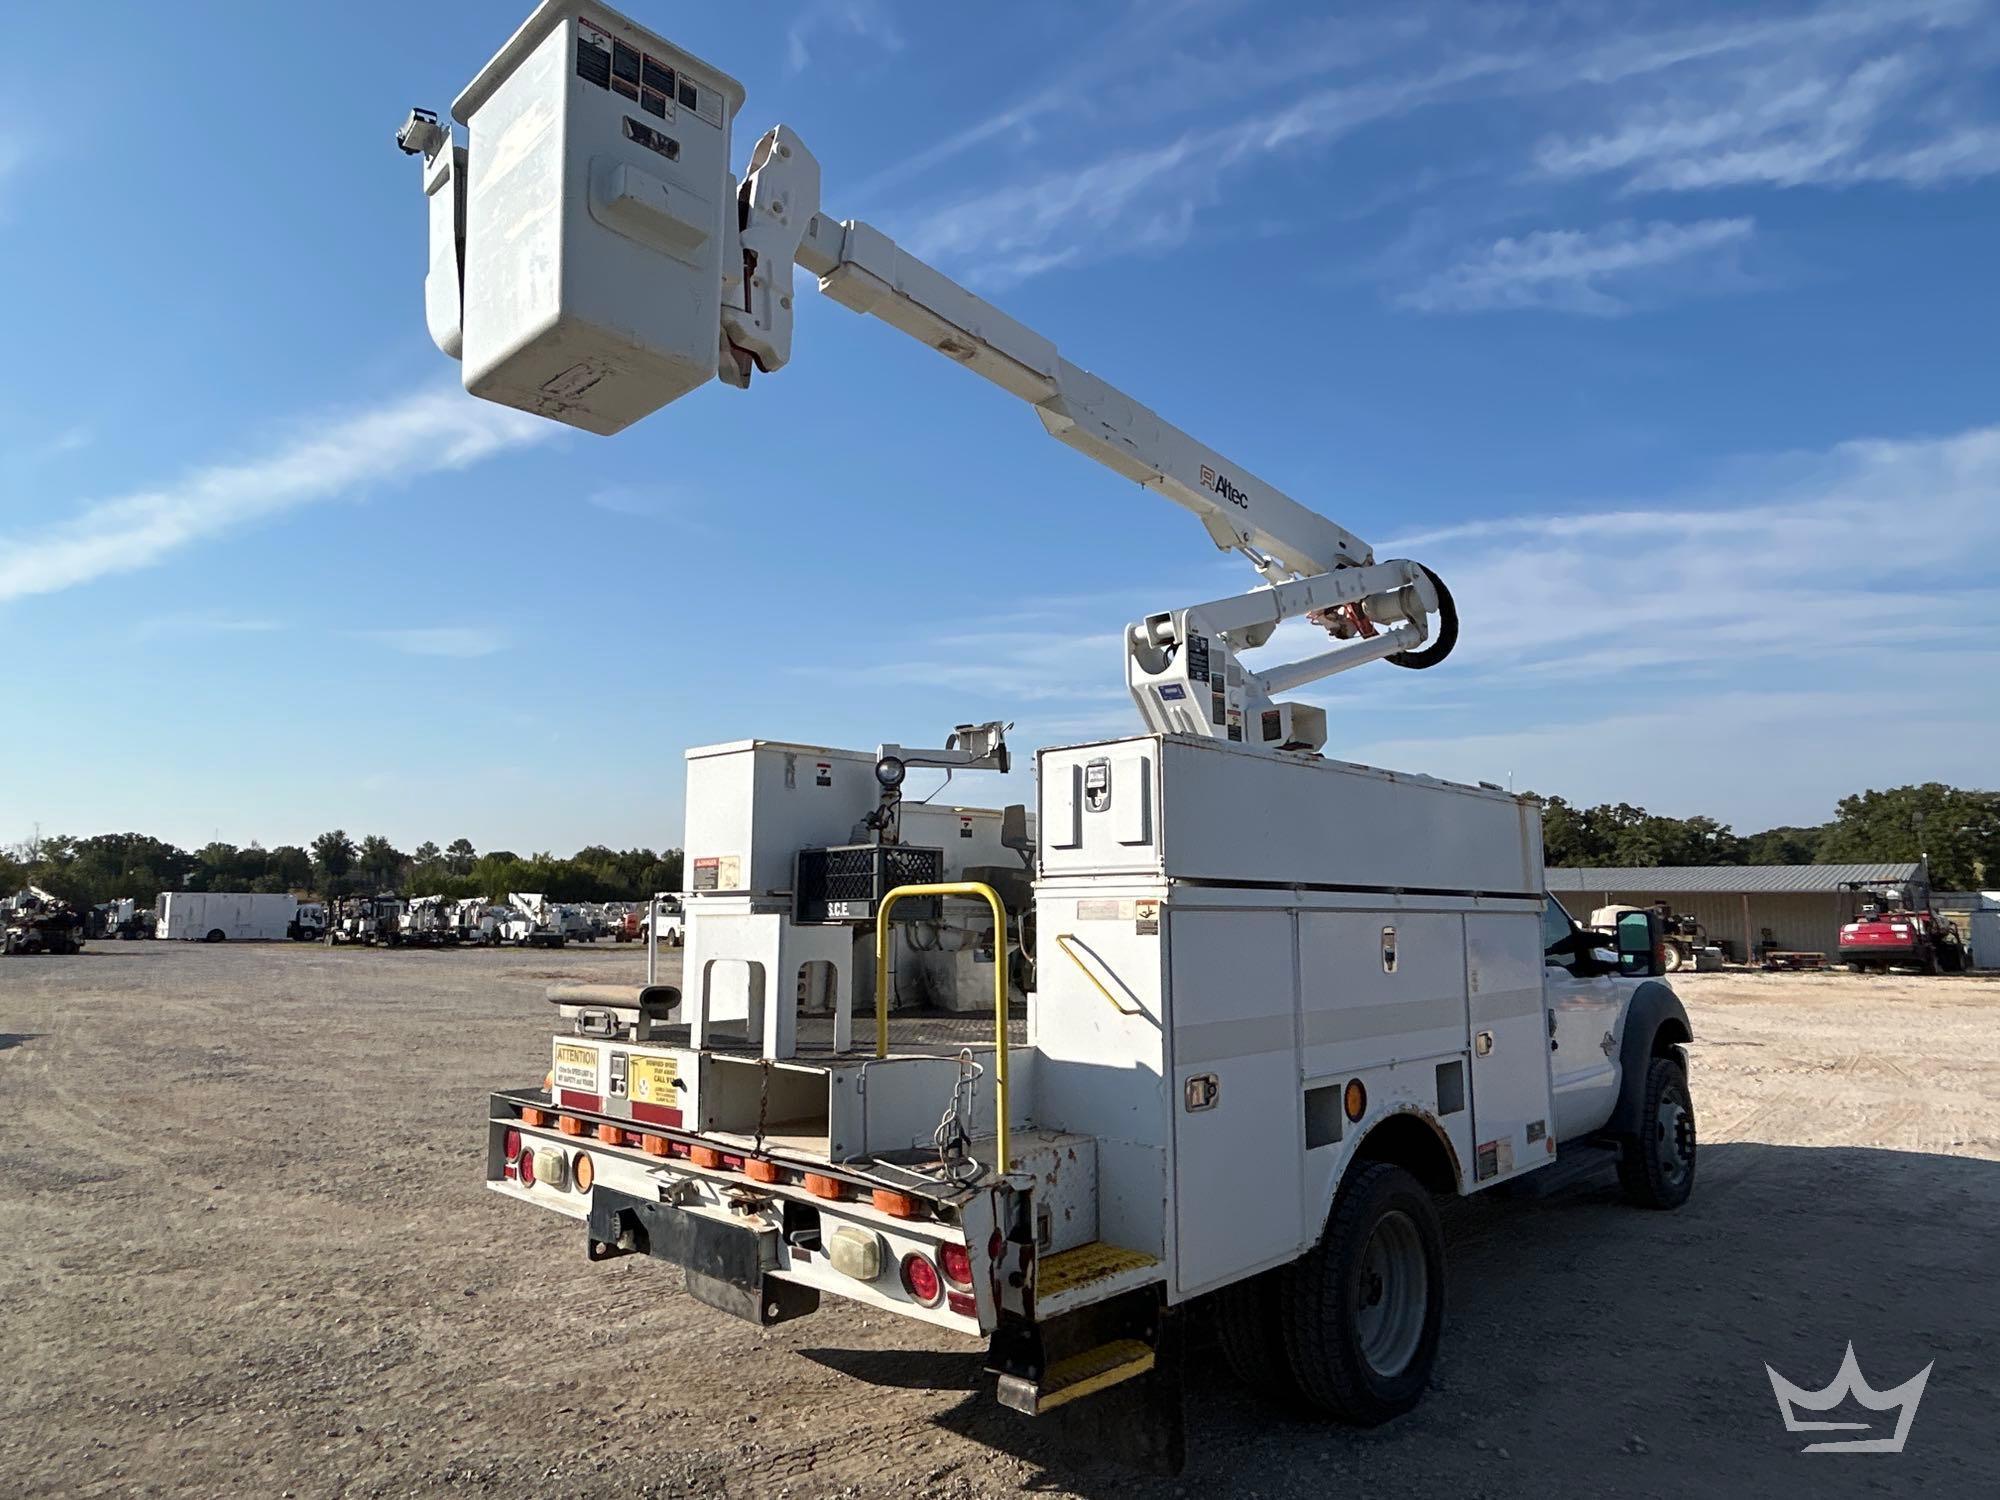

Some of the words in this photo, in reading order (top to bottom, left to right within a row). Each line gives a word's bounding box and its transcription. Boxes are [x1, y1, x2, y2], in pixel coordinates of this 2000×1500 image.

[1214, 475, 1249, 509] Altec
[557, 1047, 596, 1065] ATTENTION
[654, 1075, 666, 1083] CALL
